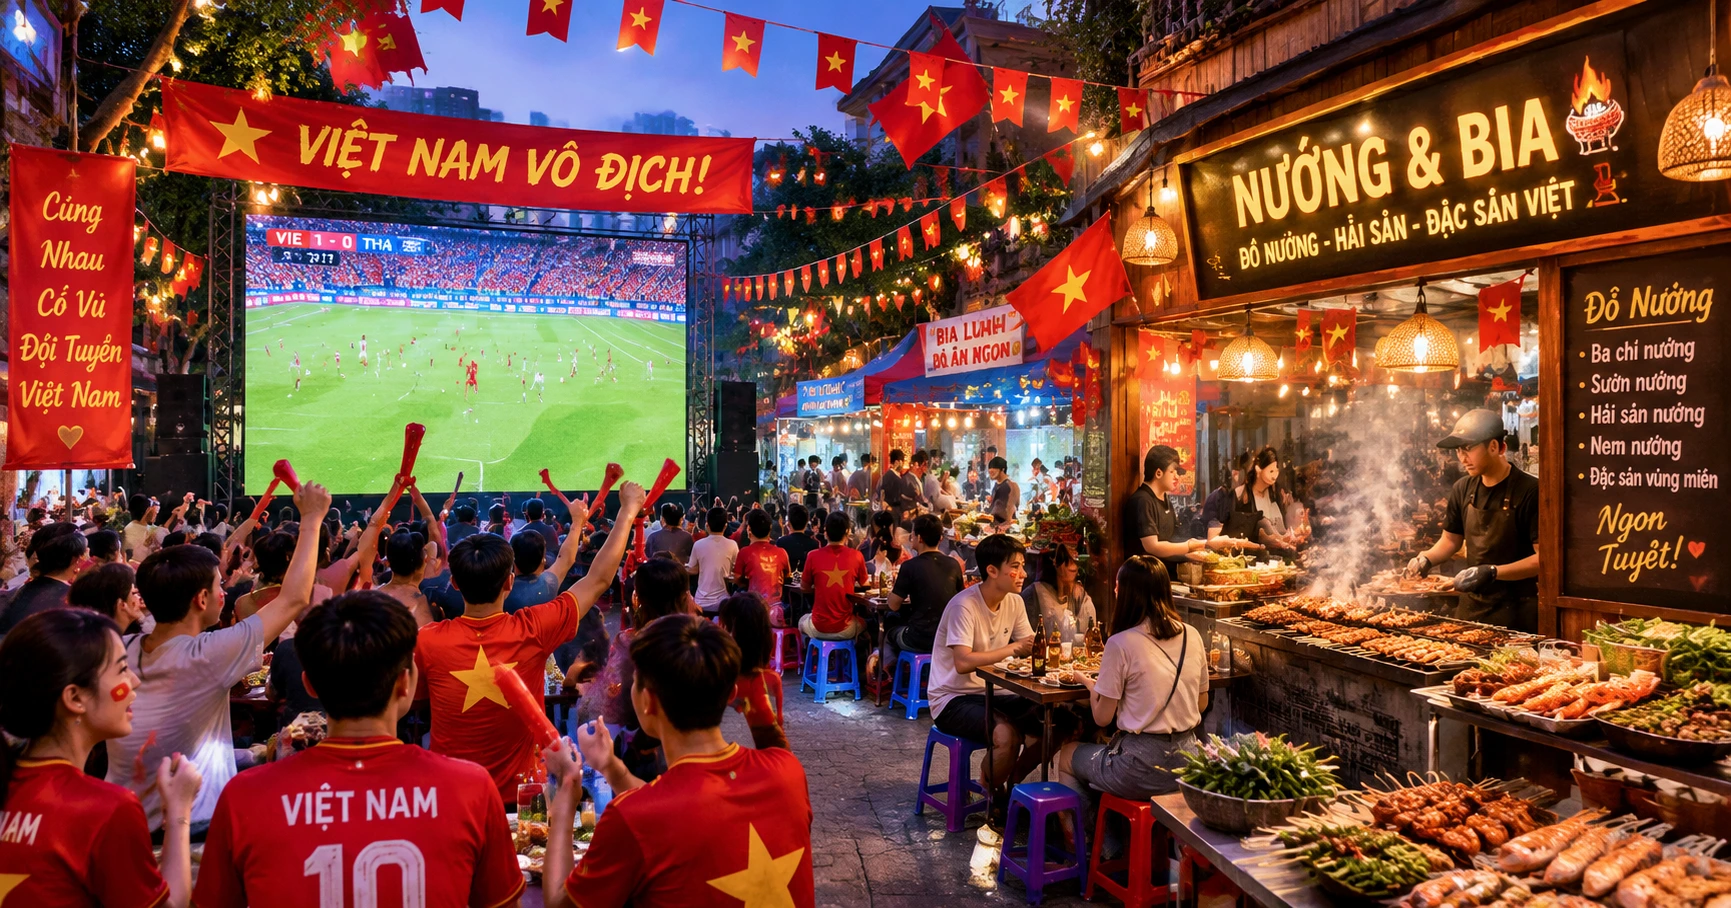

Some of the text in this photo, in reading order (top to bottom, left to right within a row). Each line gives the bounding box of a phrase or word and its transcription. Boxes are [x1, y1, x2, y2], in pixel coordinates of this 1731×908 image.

[299, 118, 712, 201] VIỆT NAM VÔ ĐỊCH!
[1232, 97, 1560, 228] NƯỚNG & BIA
[1524, 176, 1575, 220] VIỆT
[40, 239, 105, 271] Nhau
[275, 231, 303, 246] VIE
[314, 234, 322, 246] 1
[342, 235, 352, 249] 0
[362, 237, 392, 252] THA
[972, 341, 1010, 364] NGON
[1591, 343, 1611, 363] Ba
[1643, 337, 1695, 362] nướng
[19, 380, 122, 415] Việt Nam
[1635, 370, 1687, 395] nướng
[1653, 401, 1706, 428] nướng
[1590, 434, 1682, 461] Nem nướng
[1596, 502, 1668, 543] Ngon
[281, 782, 438, 832] VIỆT NAM
[304, 839, 426, 908] 10
